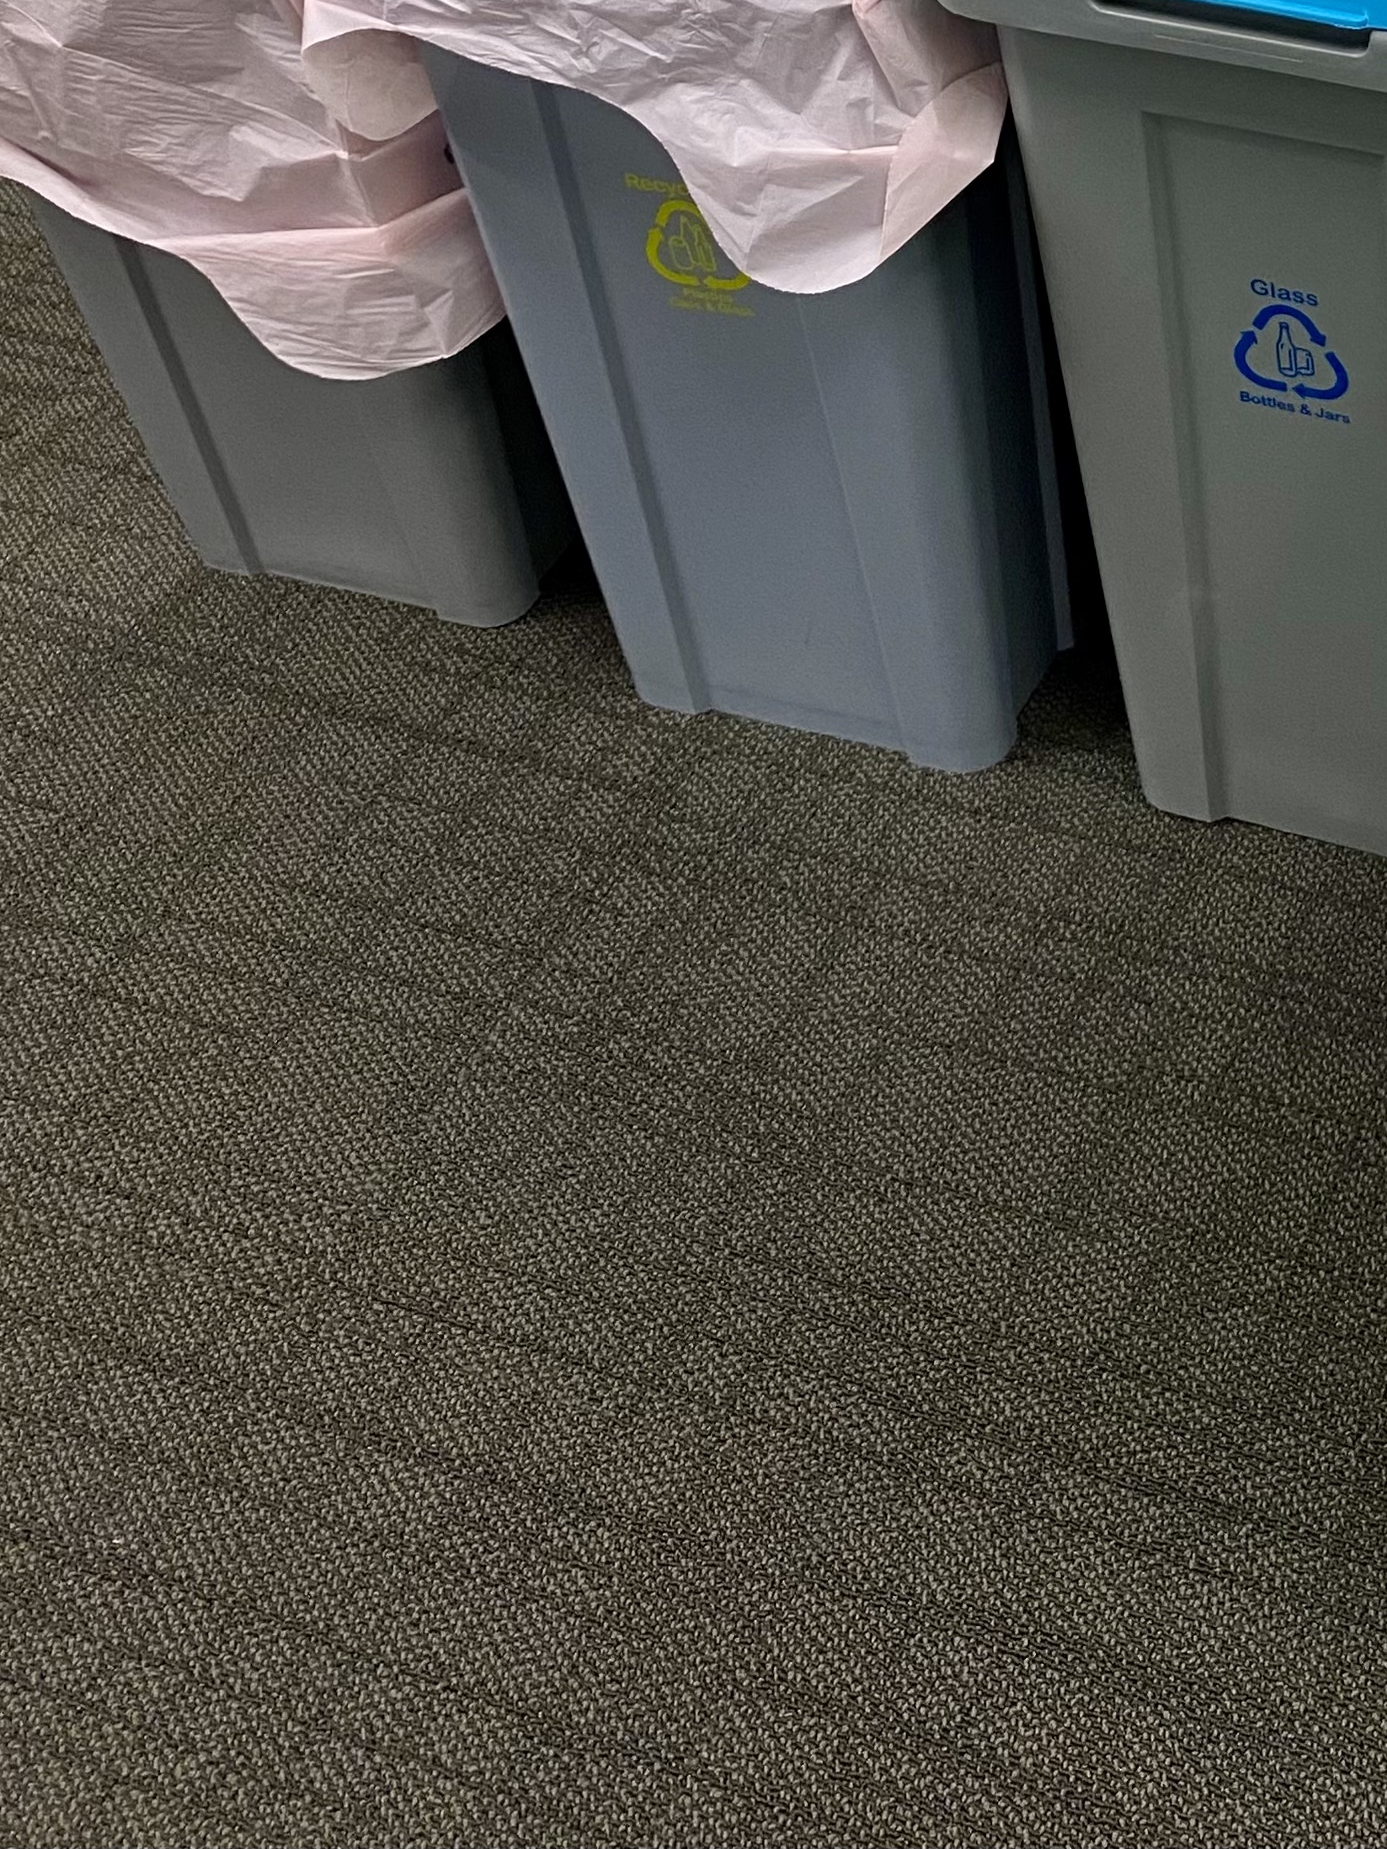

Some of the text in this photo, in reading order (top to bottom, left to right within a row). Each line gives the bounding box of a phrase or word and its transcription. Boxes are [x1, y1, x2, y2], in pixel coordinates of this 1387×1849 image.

[1250, 279, 1318, 307] Glass
[1239, 391, 1350, 423] Bottles & Jars
